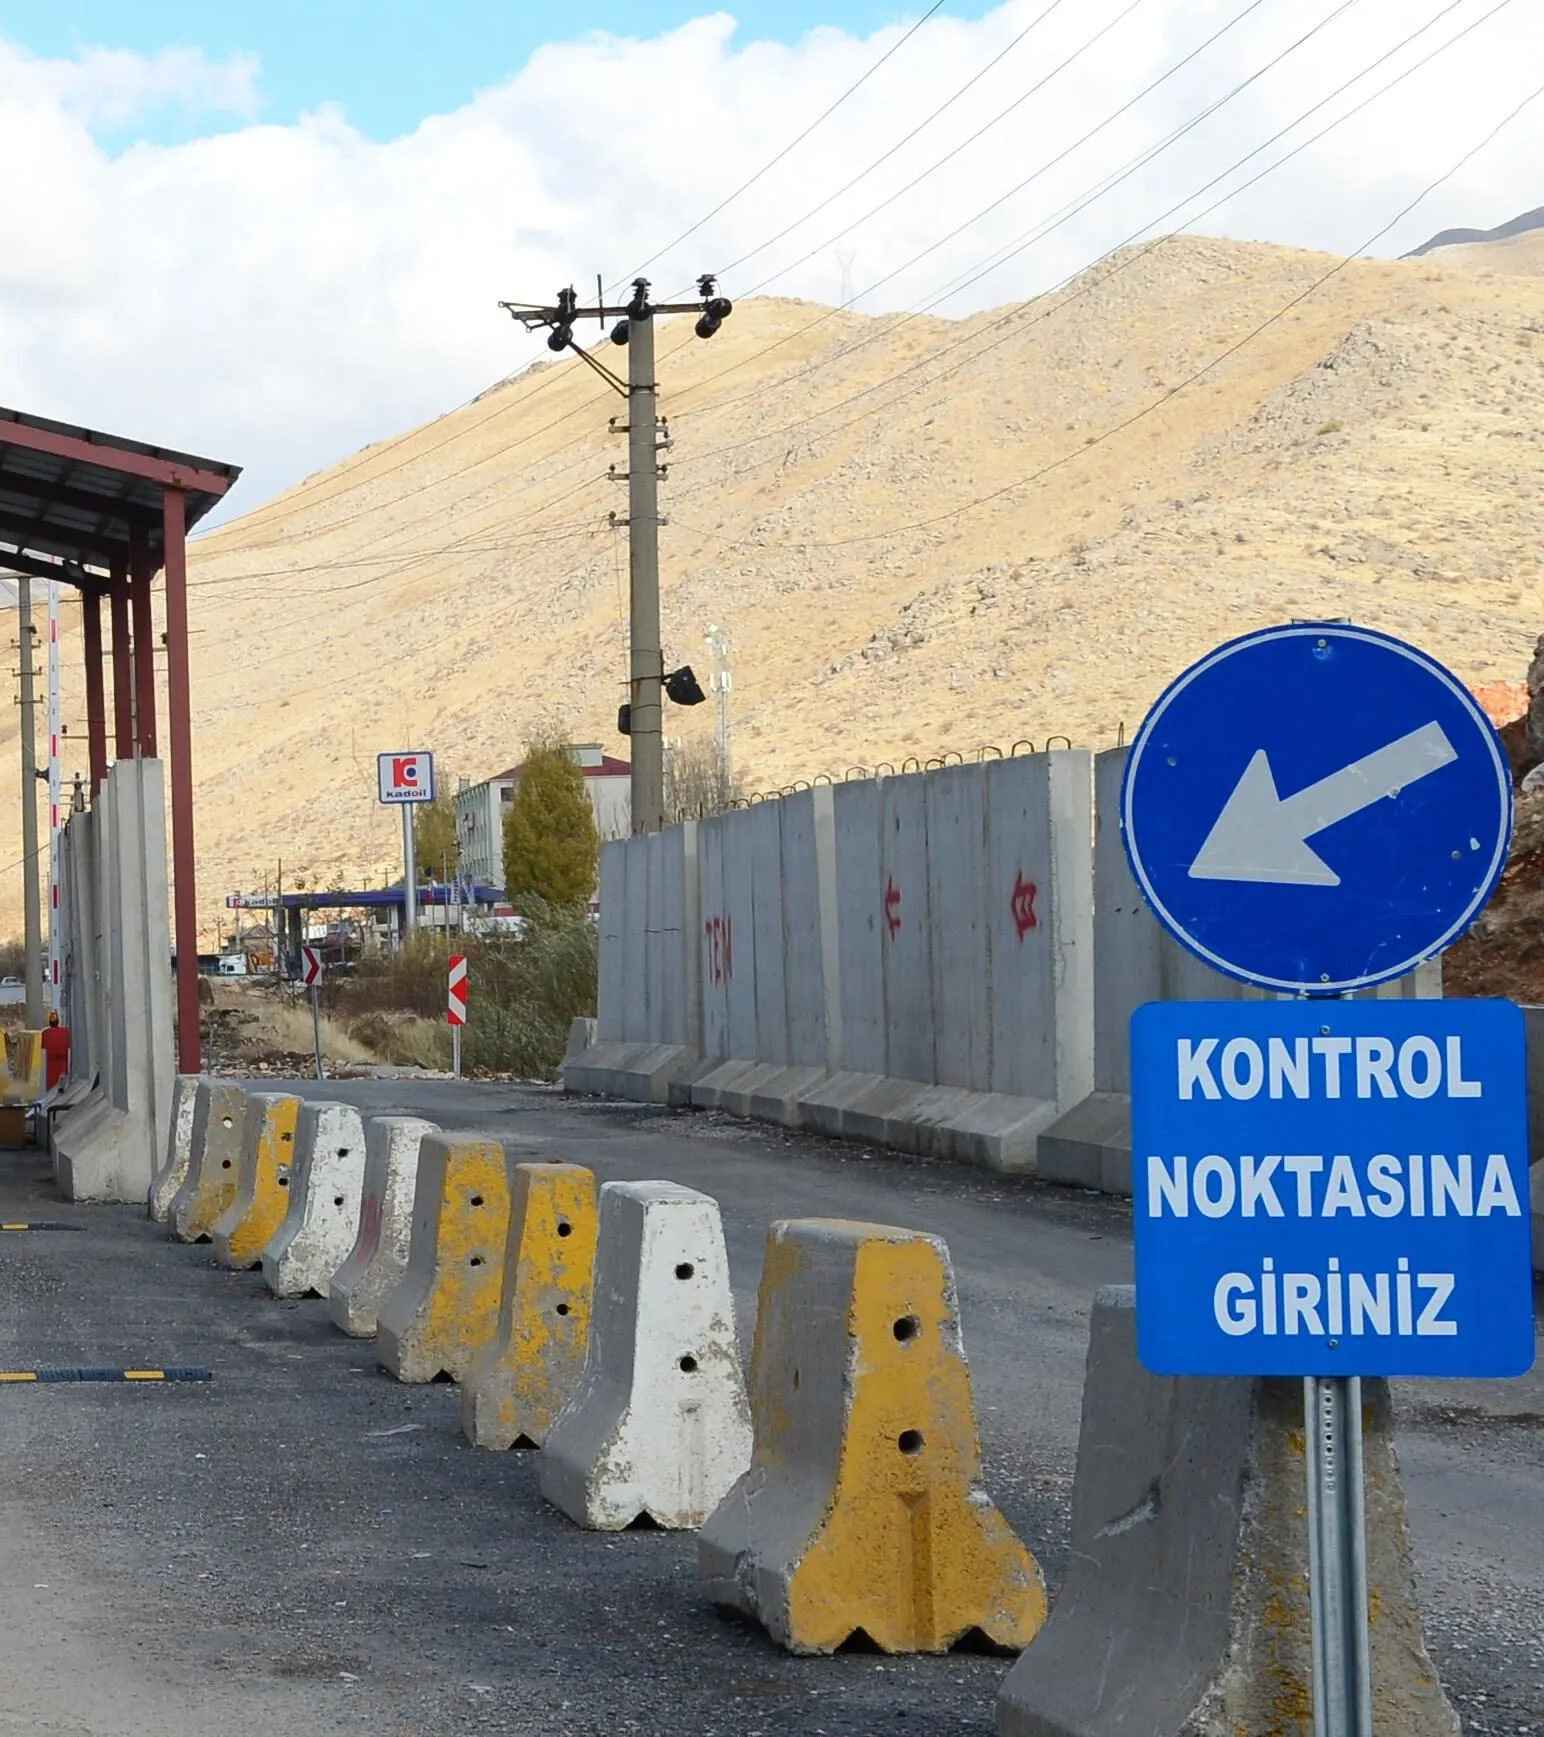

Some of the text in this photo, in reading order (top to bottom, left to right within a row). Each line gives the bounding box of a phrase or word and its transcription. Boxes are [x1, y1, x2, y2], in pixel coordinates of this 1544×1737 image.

[386, 788, 427, 799] kadoil
[1177, 1035, 1482, 1100] KONTROL
[1147, 1154, 1522, 1218] NOKTASINA
[1213, 1257, 1458, 1336] GİRİNİZ
